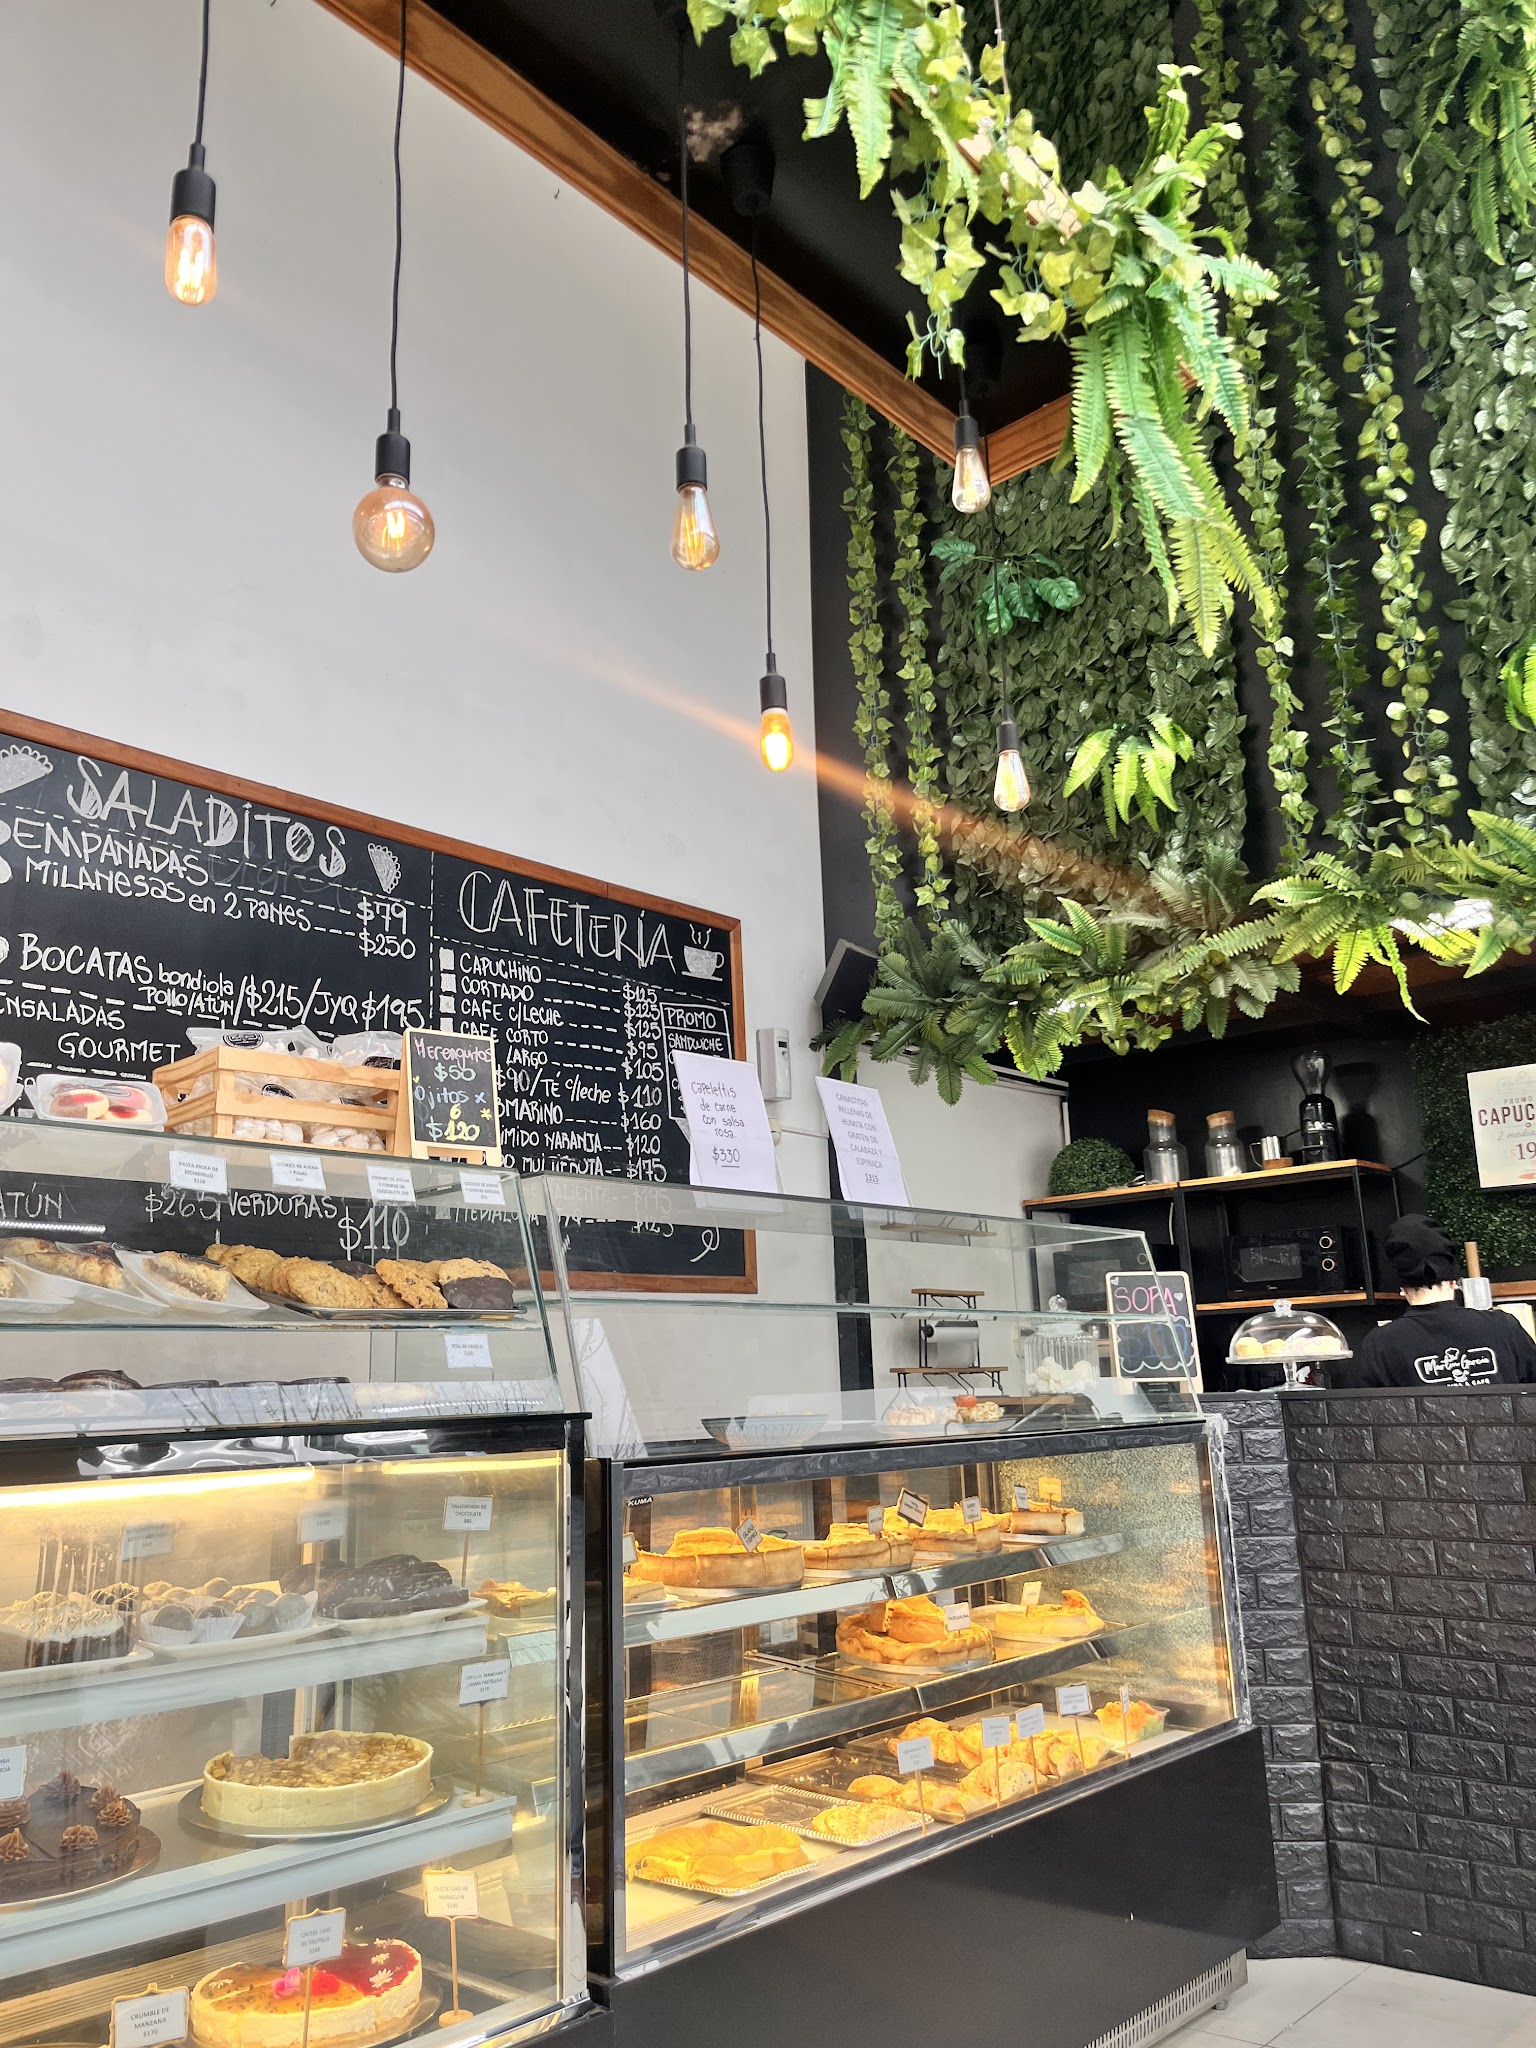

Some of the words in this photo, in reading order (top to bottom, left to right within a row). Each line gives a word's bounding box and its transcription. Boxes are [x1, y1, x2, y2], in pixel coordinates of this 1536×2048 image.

[13, 817, 209, 886] EMPANADAS
[356, 896, 407, 935] $79
[188, 894, 215, 913] en
[224, 892, 242, 919] 2
[358, 927, 416, 959] $250
[18, 932, 153, 984] BOCATAS
[460, 952, 542, 983] CAPUCHINO
[158, 963, 234, 997] bondiola
[361, 991, 425, 1030] $195
[461, 976, 534, 1001] CORTADO
[623, 1003, 661, 1022] $125
[461, 999, 503, 1021] CAFE
[624, 1020, 662, 1040] $125
[664, 1007, 716, 1030] PROMO
[58, 1032, 181, 1064] GOURMET
[460, 1021, 500, 1043] CAFE
[506, 1028, 549, 1045] CORTO
[627, 1040, 658, 1060] $95
[434, 1062, 476, 1082] $50
[506, 1045, 548, 1071] LARGO
[621, 1056, 664, 1082] $105
[618, 1082, 662, 1111] $110
[700, 1098, 710, 1112] de
[714, 1102, 737, 1113] carne
[1503, 1096, 1533, 1105] PROMO
[450, 1103, 461, 1120] 6
[620, 1112, 661, 1133] $160
[702, 1114, 717, 1125] con
[722, 1115, 745, 1127] salsa
[865, 1112, 873, 1120] DE
[1478, 1103, 1536, 1126] CAPUC
[426, 1116, 480, 1142] $120
[864, 1123, 877, 1132] CON
[1497, 1131, 1504, 1141] 2
[544, 1131, 603, 1153] NARANJA
[626, 1134, 661, 1157] $120
[712, 1146, 740, 1164] $330
[626, 1159, 667, 1183] $175
[856, 1157, 883, 1168] ESPINACA
[337, 1204, 410, 1262] $110
[1114, 1285, 1178, 1316] SOPA
[627, 1496, 653, 1507] KUMA
[130, 2008, 160, 2020] CRUMBLE
[134, 2017, 167, 2029] MANZANA
[143, 2028, 159, 2038] $170
